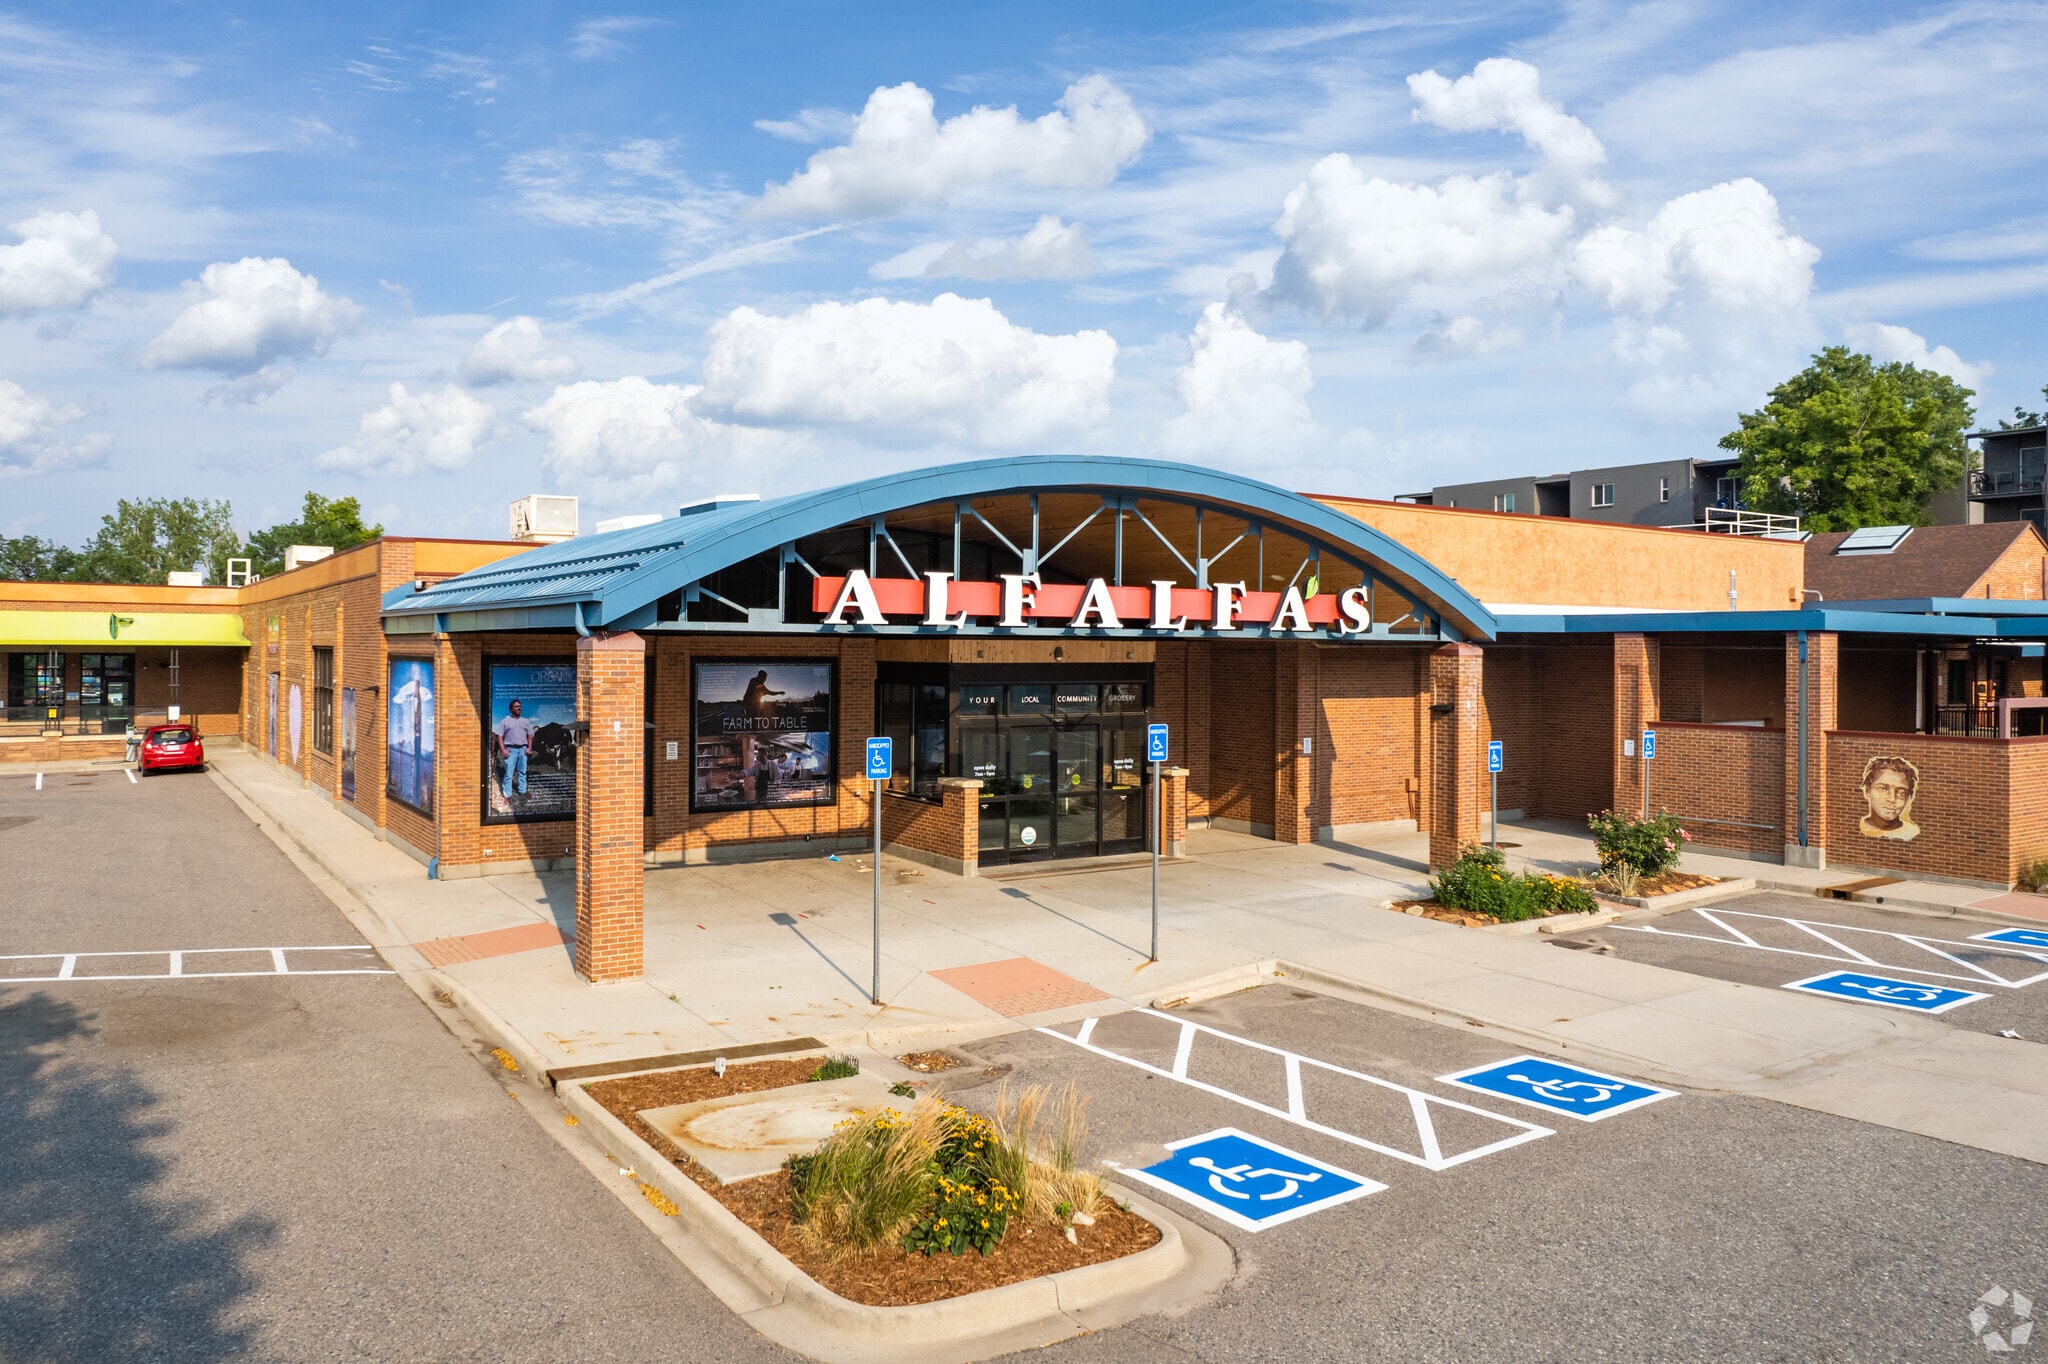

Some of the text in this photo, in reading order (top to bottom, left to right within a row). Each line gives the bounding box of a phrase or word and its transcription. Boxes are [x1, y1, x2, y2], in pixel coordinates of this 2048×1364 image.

[969, 694, 1136, 704] YOUR LOCAL COMMUNITY GROCERY
[722, 716, 808, 730] FARM TO TABLE
[1124, 757, 1134, 765] daily
